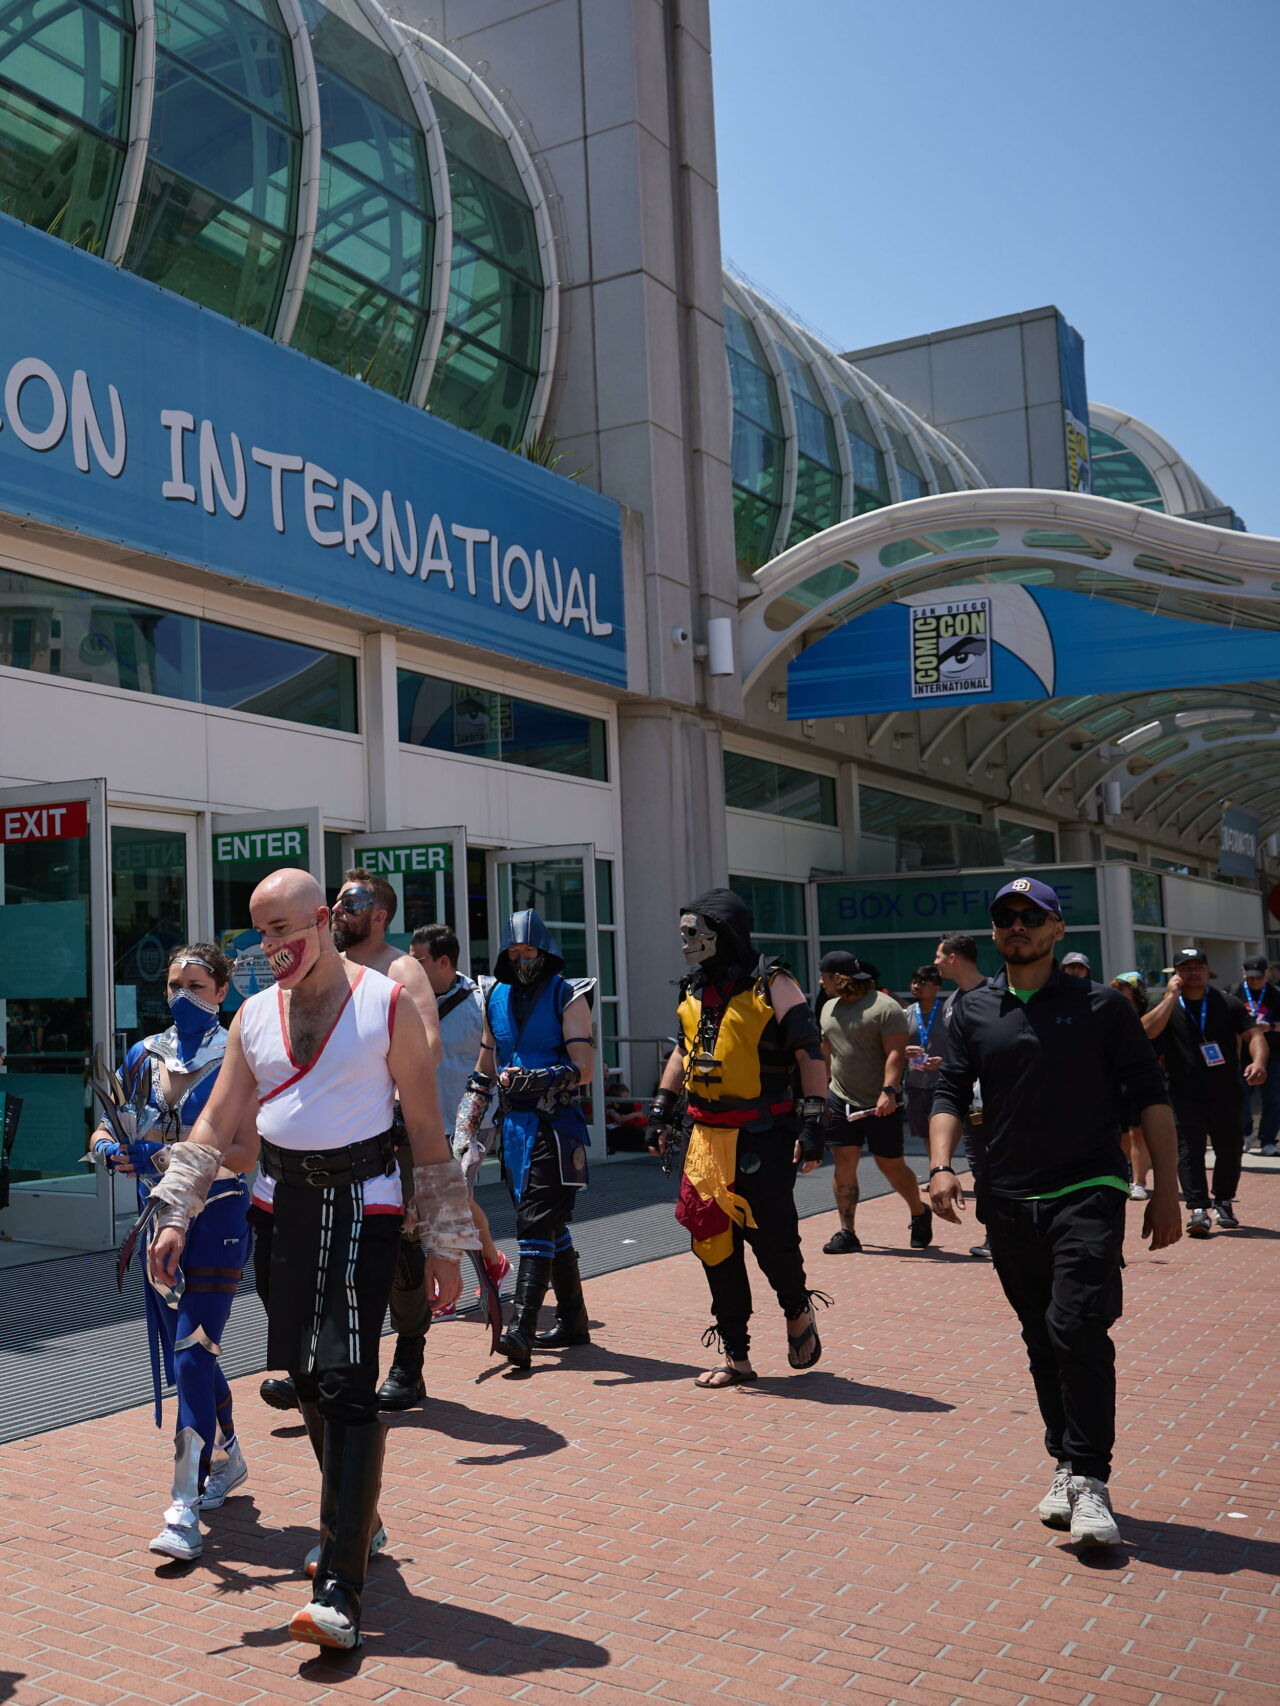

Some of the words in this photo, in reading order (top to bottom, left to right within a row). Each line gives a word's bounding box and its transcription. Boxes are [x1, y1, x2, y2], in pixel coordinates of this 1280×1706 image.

[160, 408, 613, 637] INTERNATIONAL
[913, 608, 936, 617] SAN
[947, 601, 987, 614] DIEGO
[940, 611, 986, 637] CON
[914, 617, 939, 684] COMIC
[914, 679, 989, 694] INTERNATIONAL
[4, 807, 67, 840] EXIT
[217, 830, 302, 862] ENTER
[361, 846, 445, 874] ENTER
[839, 893, 903, 920] BOX
[915, 885, 1073, 917] OFFIE
